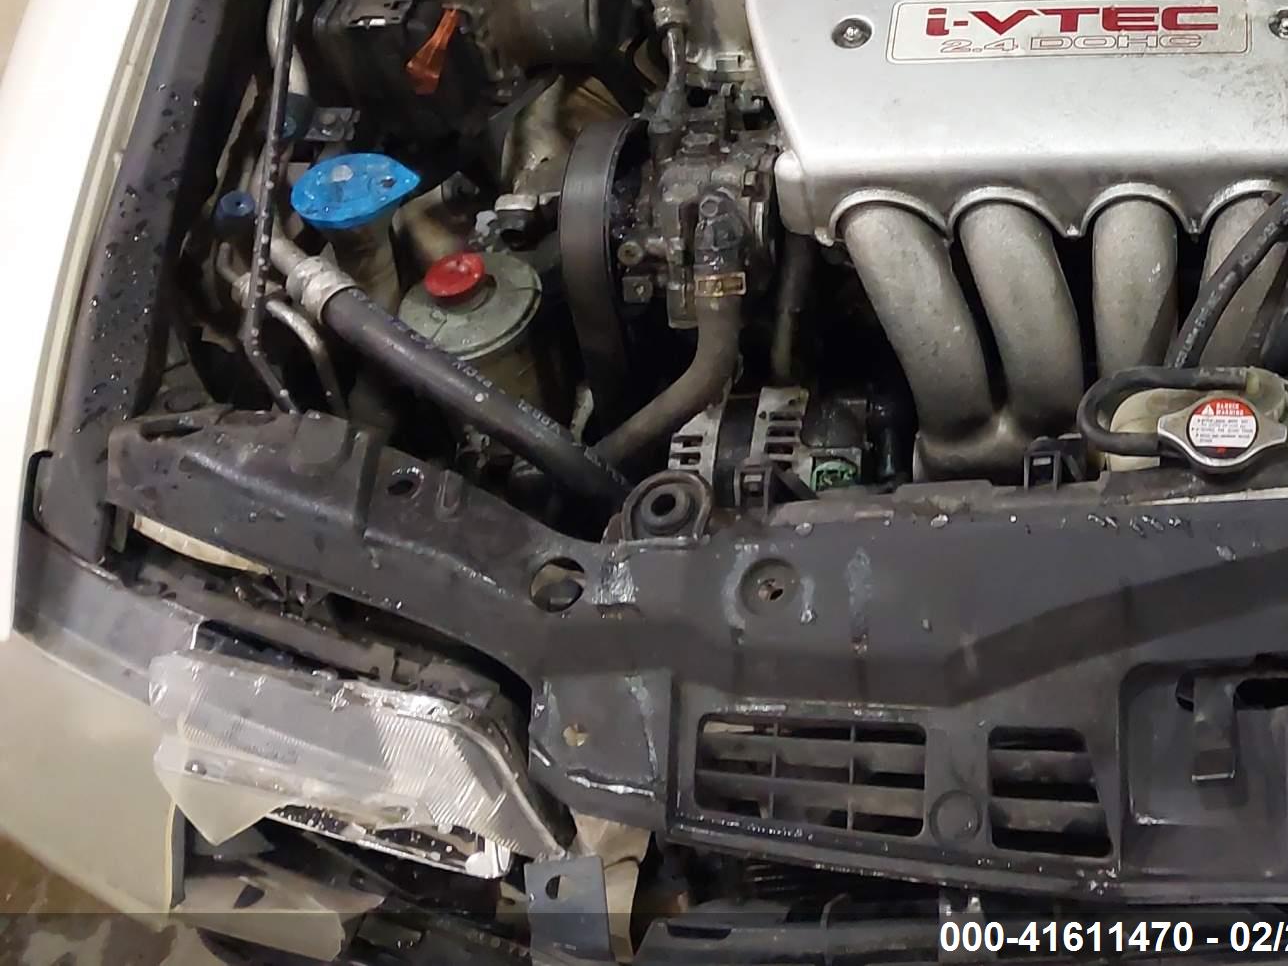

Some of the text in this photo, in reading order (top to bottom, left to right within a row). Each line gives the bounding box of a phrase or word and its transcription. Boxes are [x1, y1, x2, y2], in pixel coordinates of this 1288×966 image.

[925, 6, 1219, 37] i-VTEC
[940, 34, 1204, 54] 2.4 DOHC
